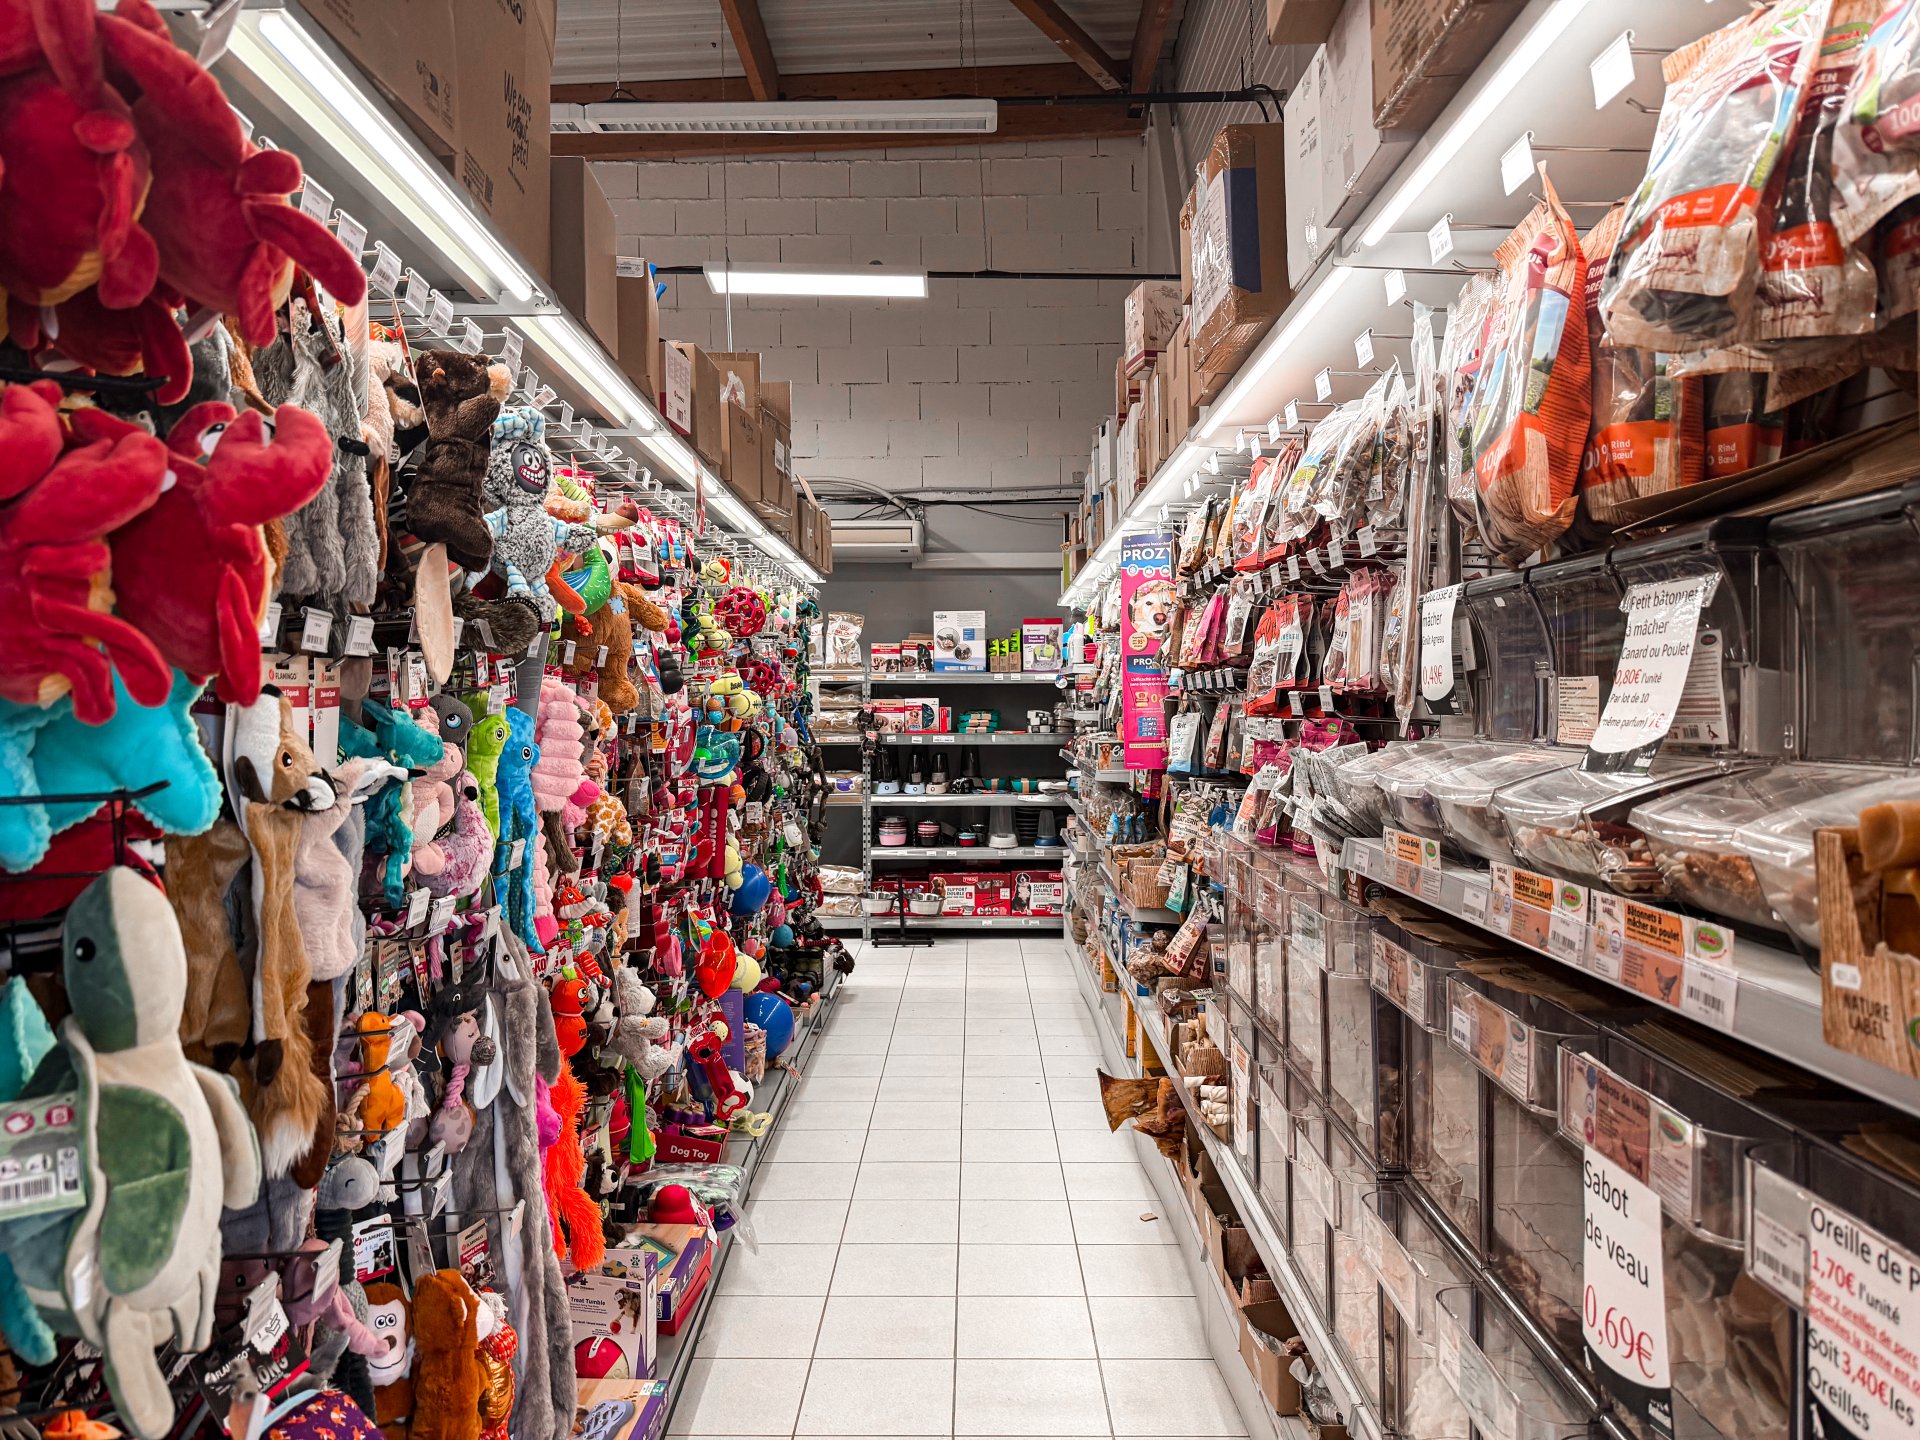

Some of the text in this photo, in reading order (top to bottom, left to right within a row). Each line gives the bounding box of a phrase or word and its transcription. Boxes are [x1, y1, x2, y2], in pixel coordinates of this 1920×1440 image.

[504, 69, 532, 121] We care
[511, 138, 530, 171] pets!
[1610, 439, 1631, 449] Rind
[1718, 442, 1736, 451] Rind
[1611, 449, 1634, 461] Bœuf
[1631, 592, 1651, 610] Petit
[1422, 612, 1443, 627] mâcher
[1626, 618, 1669, 637] à mâcher
[1621, 642, 1690, 660] Canard ou Poulet
[698, 659, 711, 667] ONG
[1133, 658, 1153, 666] PRO
[275, 672, 297, 680] FLAMINGO
[1422, 665, 1443, 687] 0,48€
[1614, 669, 1662, 685] 0,80€ l'unité
[1610, 693, 1650, 704] Par lot de 10
[1514, 872, 1536, 887] Bâtonnets
[1514, 882, 1531, 892] mâcher
[1537, 889, 1552, 900] canard
[1627, 904, 1658, 923] Bâtonnets
[1627, 917, 1649, 932] mâcher
[1649, 925, 1658, 934] au
[1658, 928, 1680, 942] poulet
[1843, 994, 1889, 1023] NATURE
[1848, 1011, 1886, 1041] LABEL
[670, 1145, 710, 1161] Dog Toy
[1584, 1159, 1629, 1218] Sabot
[362, 1230, 389, 1243] FLAMINGO
[1810, 1207, 1872, 1265] Oreille
[1877, 1249, 1902, 1284] de
[1584, 1212, 1649, 1289] de veau
[1810, 1250, 1900, 1326] 1,70€ l'unité
[585, 1298, 606, 1306] Tumble
[1584, 1284, 1656, 1379] 0,69€
[1841, 1305, 1877, 1337] oreilles
[1879, 1329, 1892, 1347] de
[256, 1356, 289, 1390] ONG
[1808, 1327, 1915, 1426] Soit 3,40€ les
[1808, 1366, 1870, 1432] Oreilles
